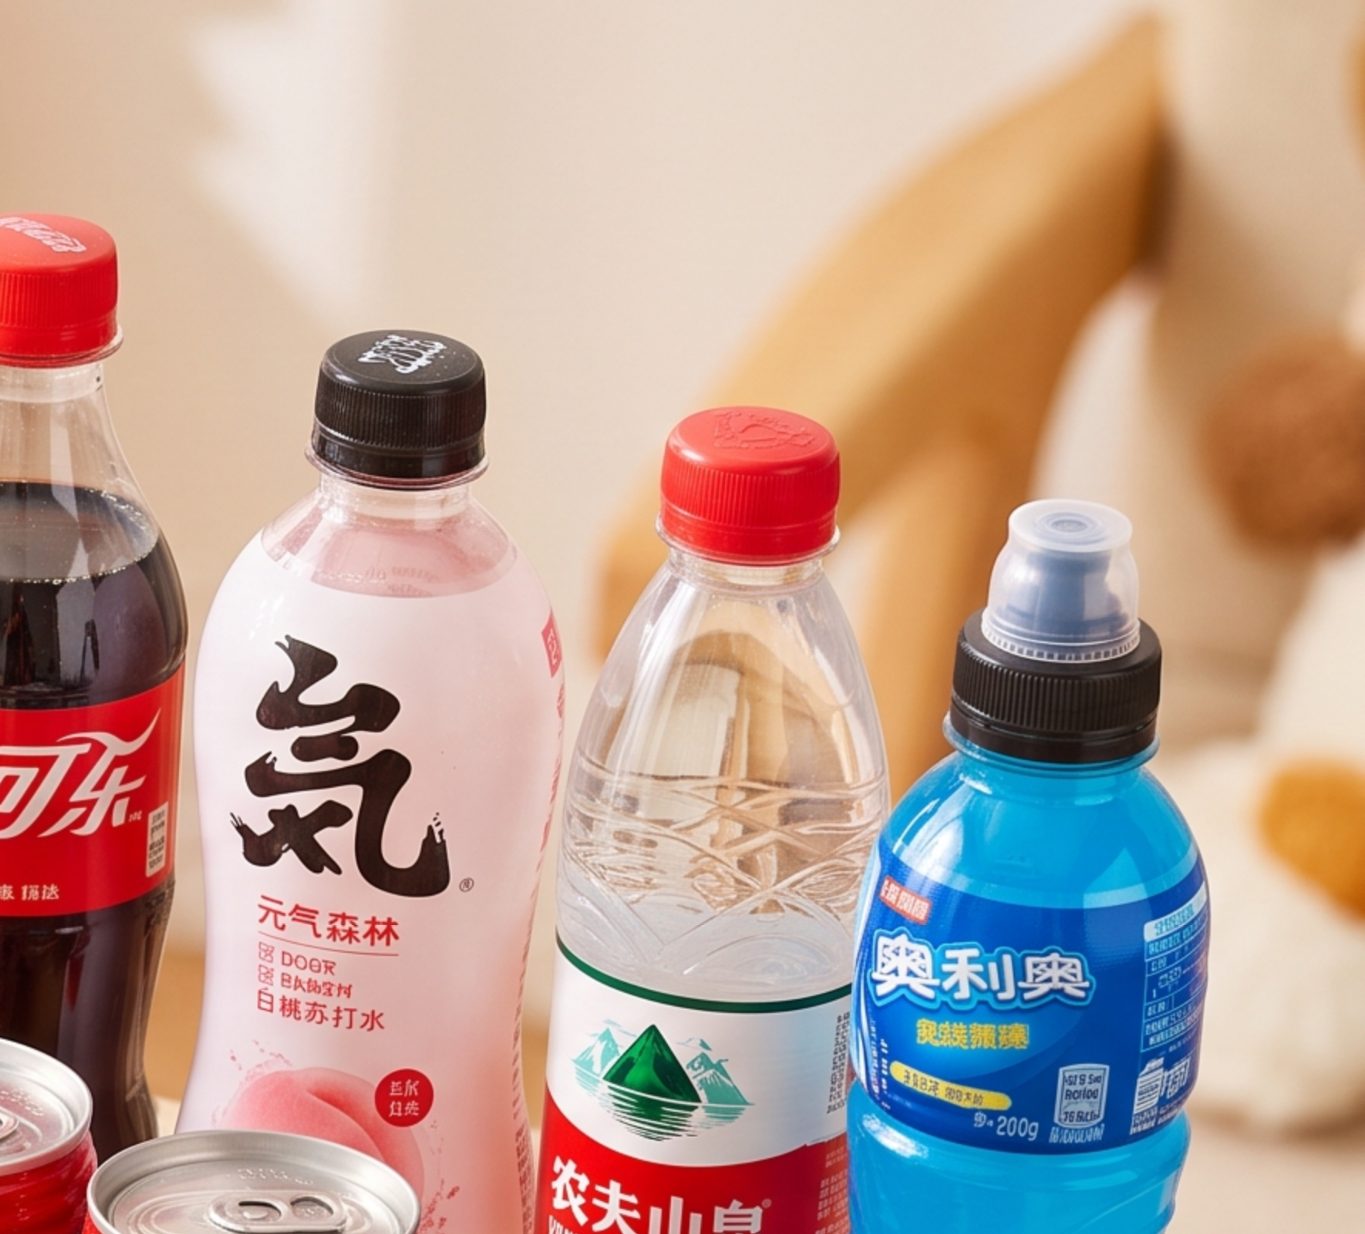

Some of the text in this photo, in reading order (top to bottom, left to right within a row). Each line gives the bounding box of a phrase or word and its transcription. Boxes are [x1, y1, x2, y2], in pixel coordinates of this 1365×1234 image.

[257, 894, 400, 947] 元气森林
[871, 932, 1091, 1001] 奥利奥
[257, 987, 386, 1032] 白桃苏打水
[996, 1115, 1039, 1141] 200g
